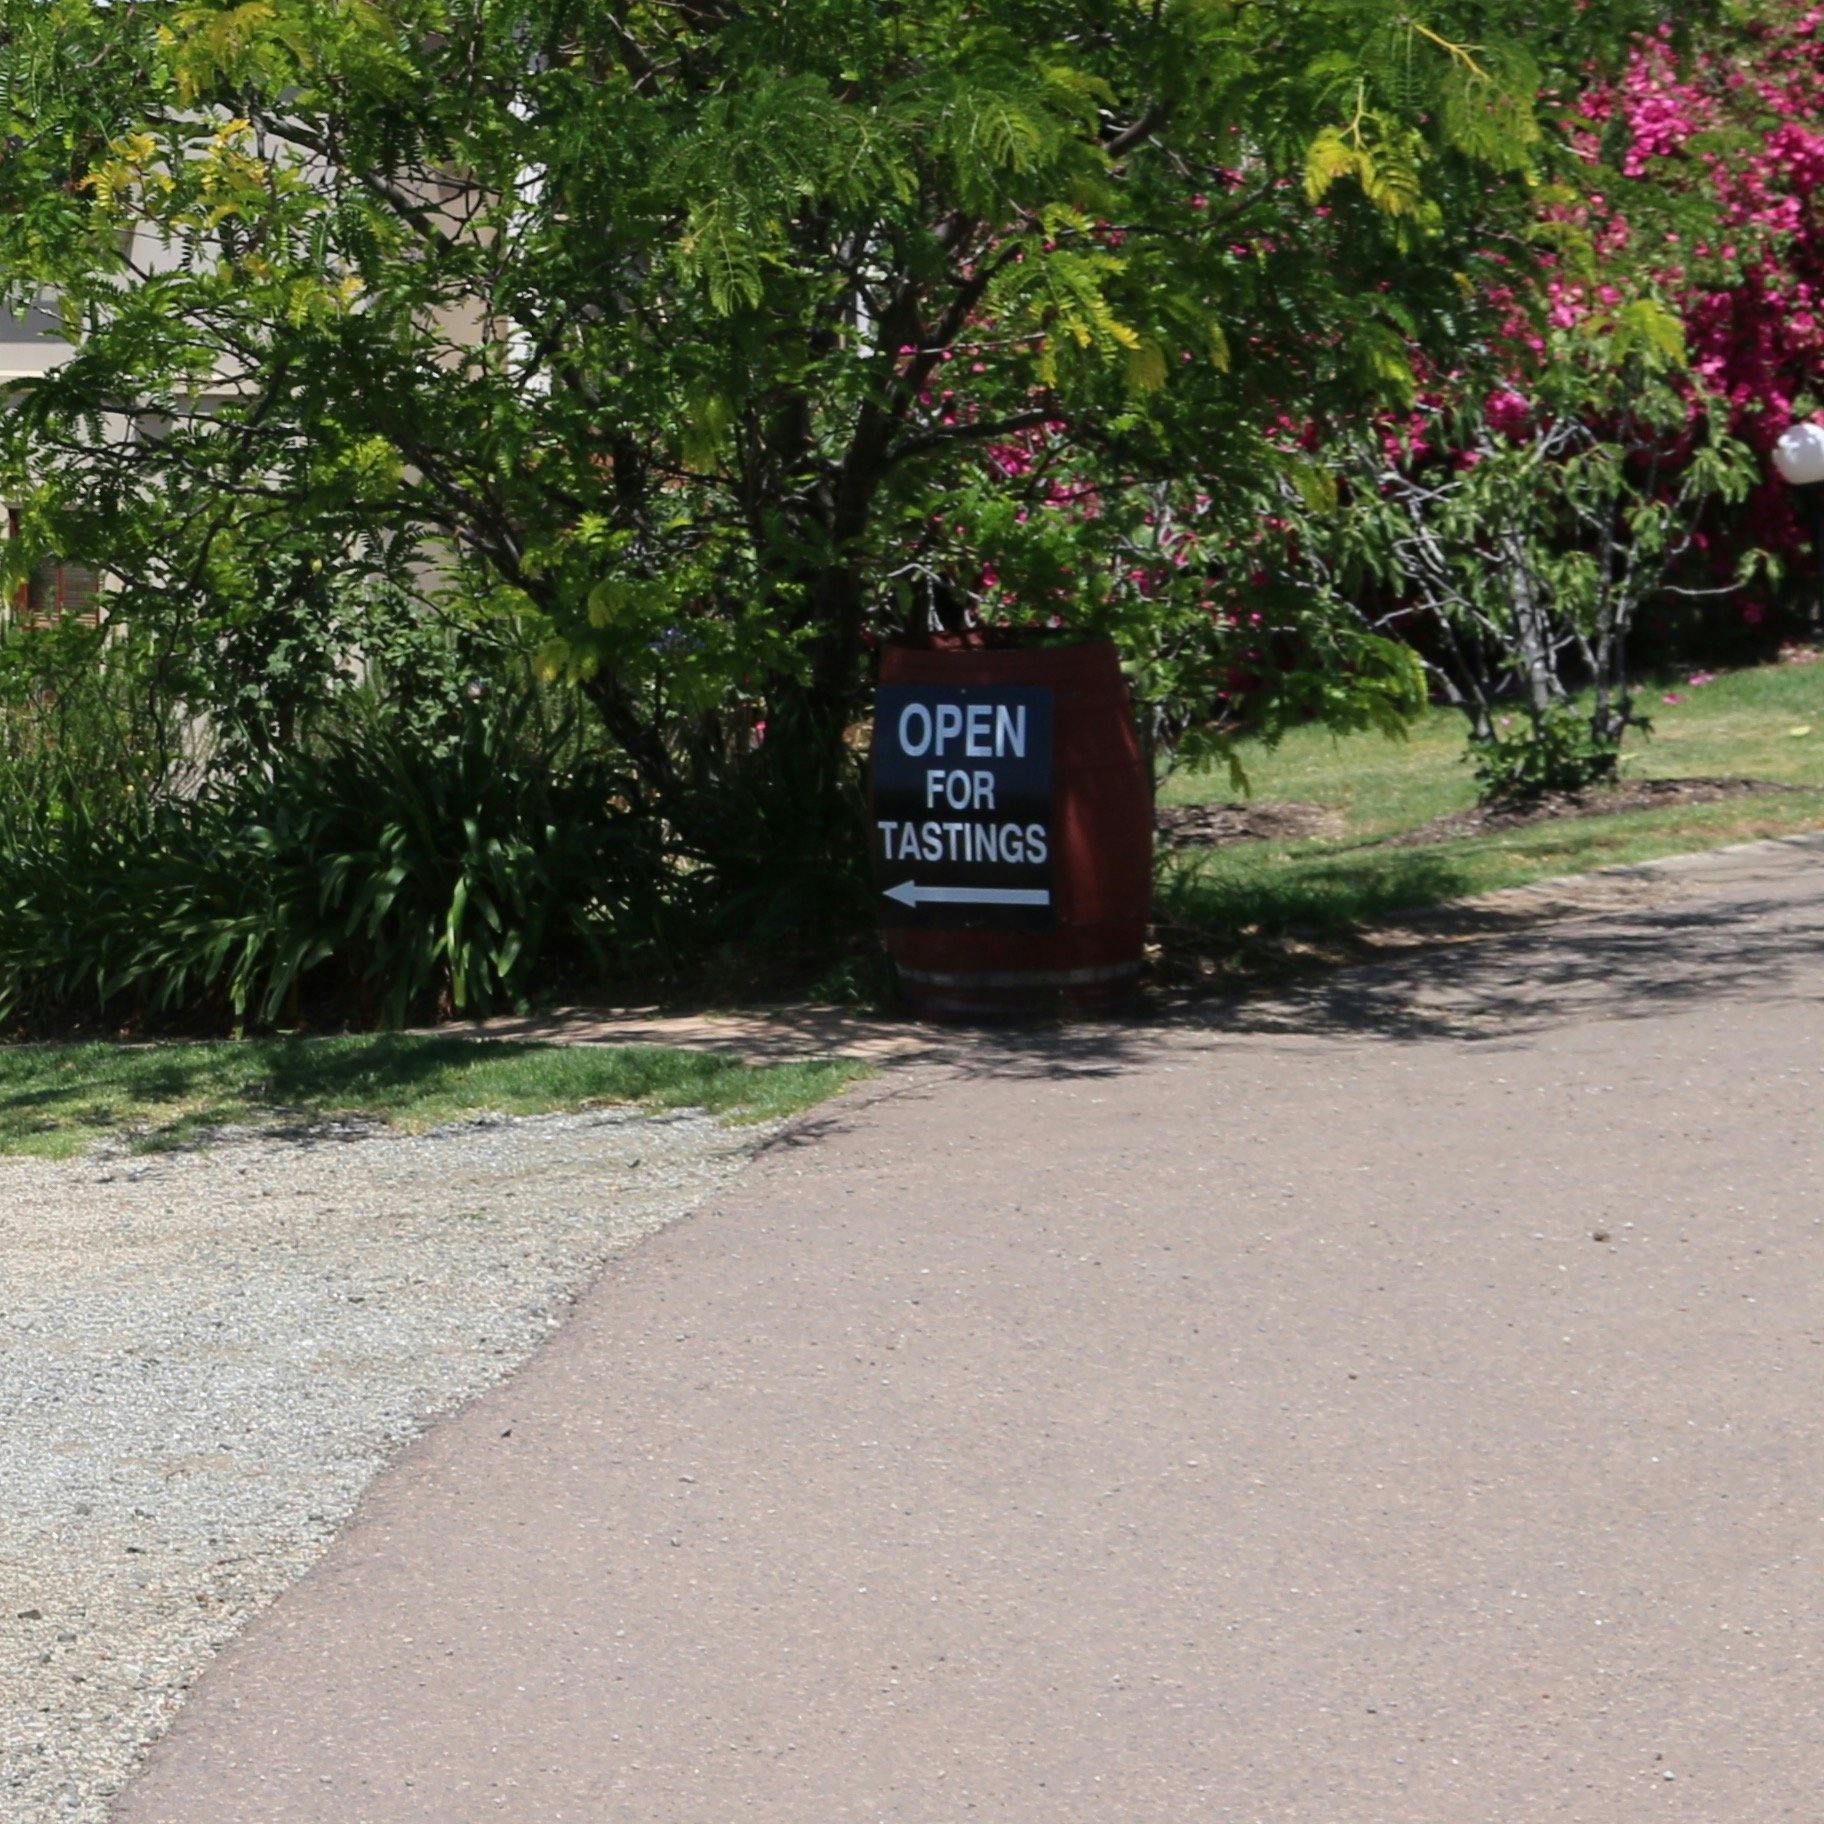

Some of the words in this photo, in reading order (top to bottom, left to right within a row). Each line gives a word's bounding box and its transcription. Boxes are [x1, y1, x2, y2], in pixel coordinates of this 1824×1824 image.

[898, 703, 1026, 758] OPEN
[926, 769, 995, 810] FOR
[877, 821, 1048, 864] TASTINGS
